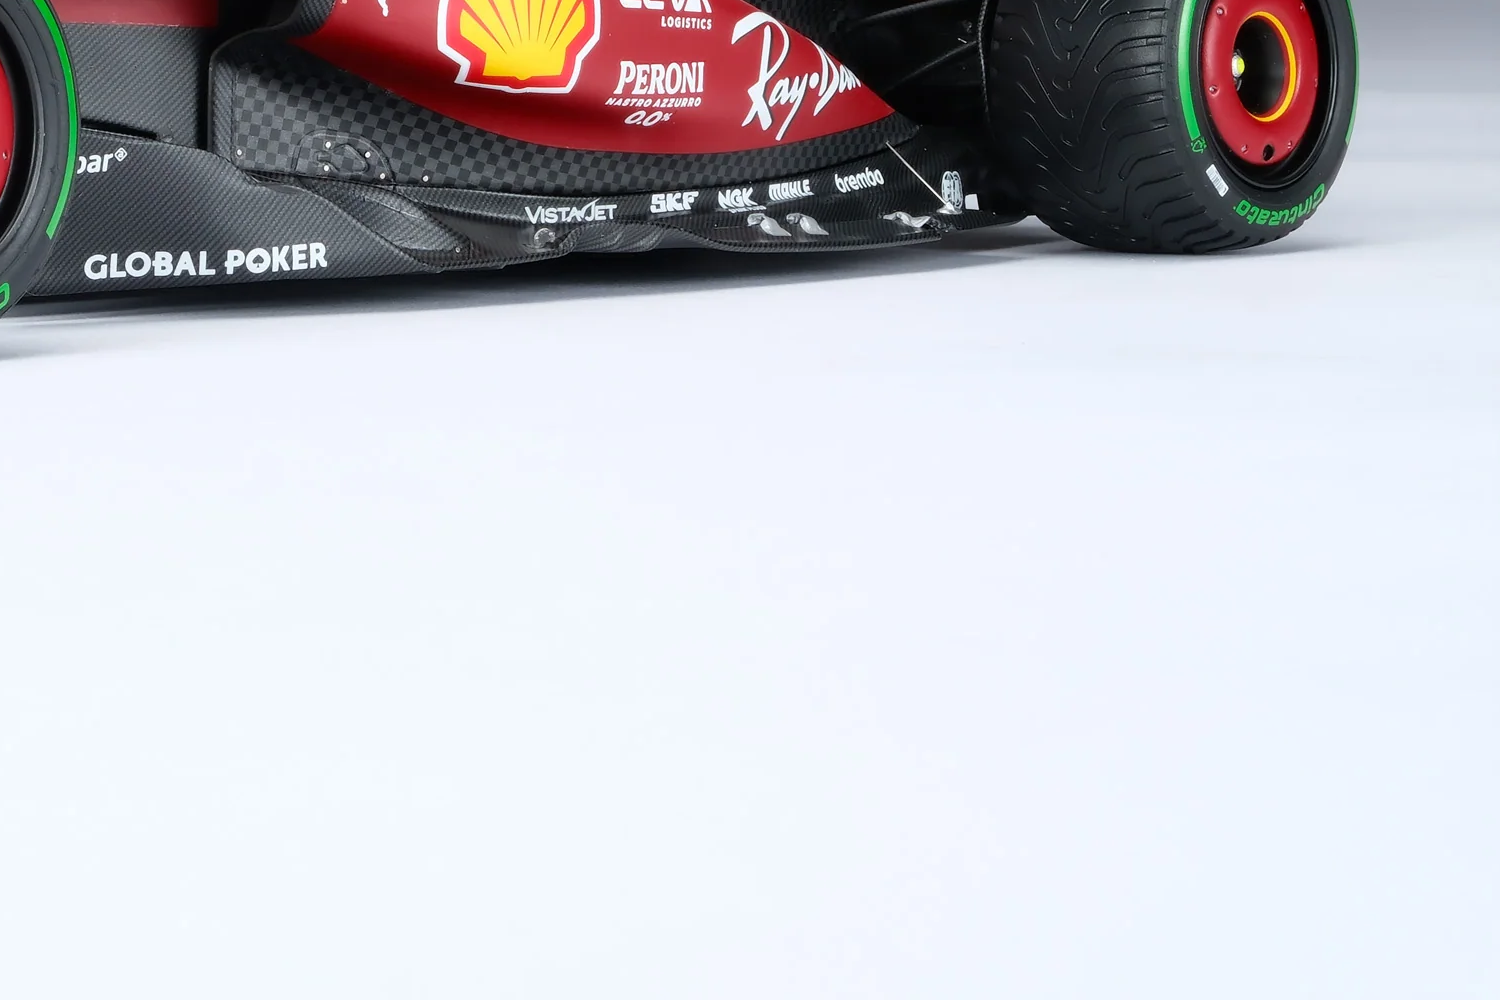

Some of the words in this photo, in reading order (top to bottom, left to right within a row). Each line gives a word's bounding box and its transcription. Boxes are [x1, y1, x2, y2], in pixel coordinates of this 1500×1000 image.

[661, 15, 712, 30] LOGISTICS
[614, 61, 704, 94] PERONI
[605, 98, 652, 108] NASTRO
[653, 97, 701, 108] AZZURRO
[624, 110, 673, 126] 0.0%
[769, 179, 814, 201] MAHLE
[835, 167, 885, 193] brembo
[650, 191, 699, 213] SKF
[718, 187, 758, 209] NGK
[1233, 183, 1325, 226] Cinturato
[84, 251, 216, 280] GLOBAL
[224, 242, 328, 275] POKER
